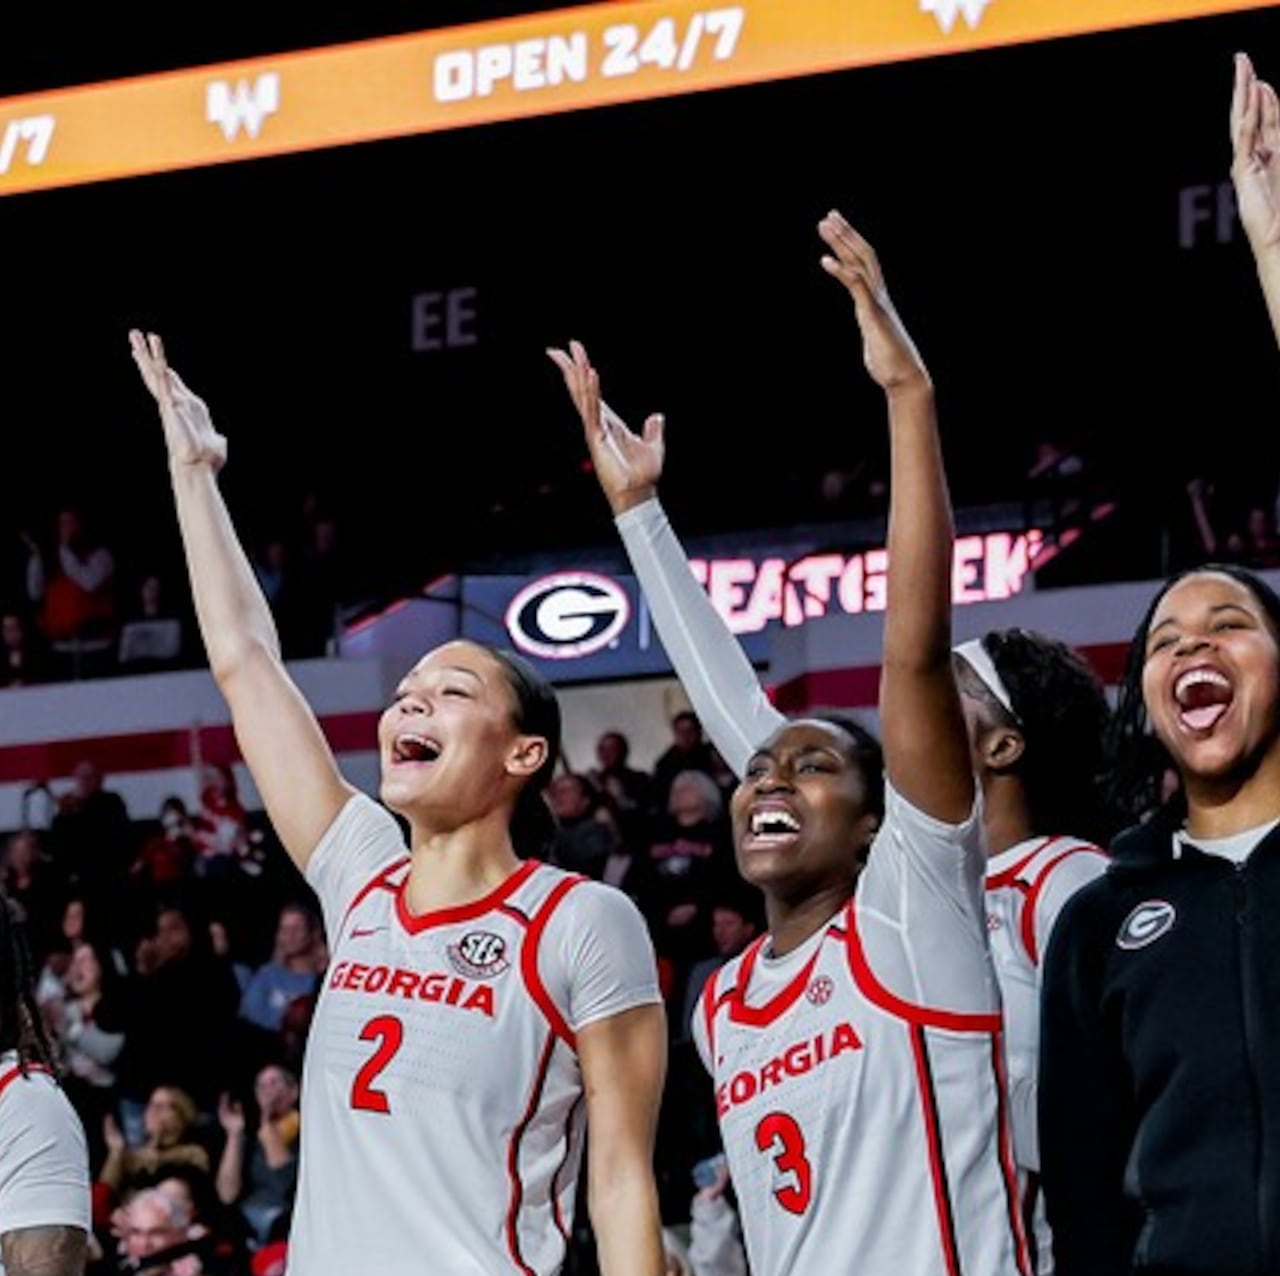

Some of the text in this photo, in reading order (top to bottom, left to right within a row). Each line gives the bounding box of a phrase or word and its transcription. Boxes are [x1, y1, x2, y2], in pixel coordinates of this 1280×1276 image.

[433, 7, 744, 102] OPEN 24/7
[411, 286, 479, 352] EE
[328, 960, 495, 1017] GEORGIA
[350, 1013, 404, 1115] 2
[716, 1022, 863, 1117] EORGIA
[754, 1110, 812, 1216] 3
